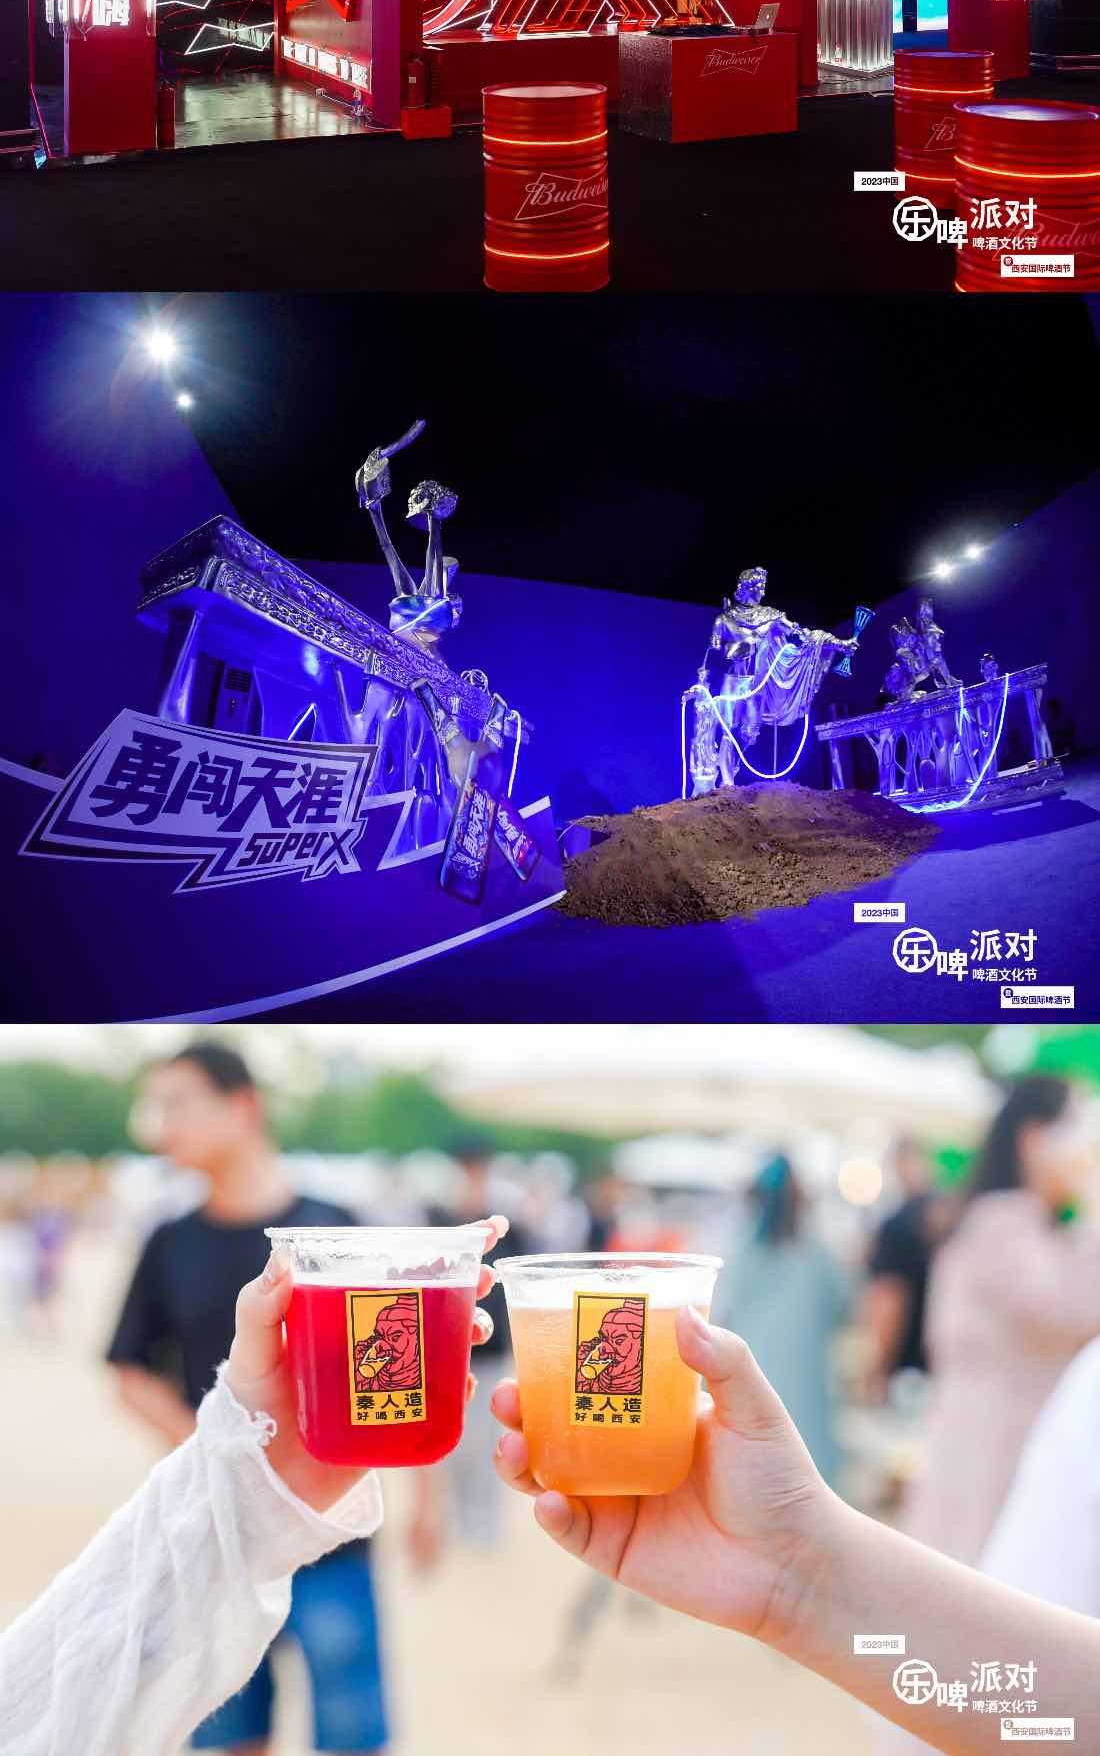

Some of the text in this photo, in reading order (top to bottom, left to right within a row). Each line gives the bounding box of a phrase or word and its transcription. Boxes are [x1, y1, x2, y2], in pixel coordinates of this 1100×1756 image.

[707, 52, 762, 69] Budweiser
[89, 730, 344, 834] 勇闯天涯
[355, 1392, 423, 1410] 秦人造
[575, 1395, 642, 1412] 秦人造
[357, 1408, 423, 1423] 好喝西安
[574, 1411, 642, 1424] 好喝西安
